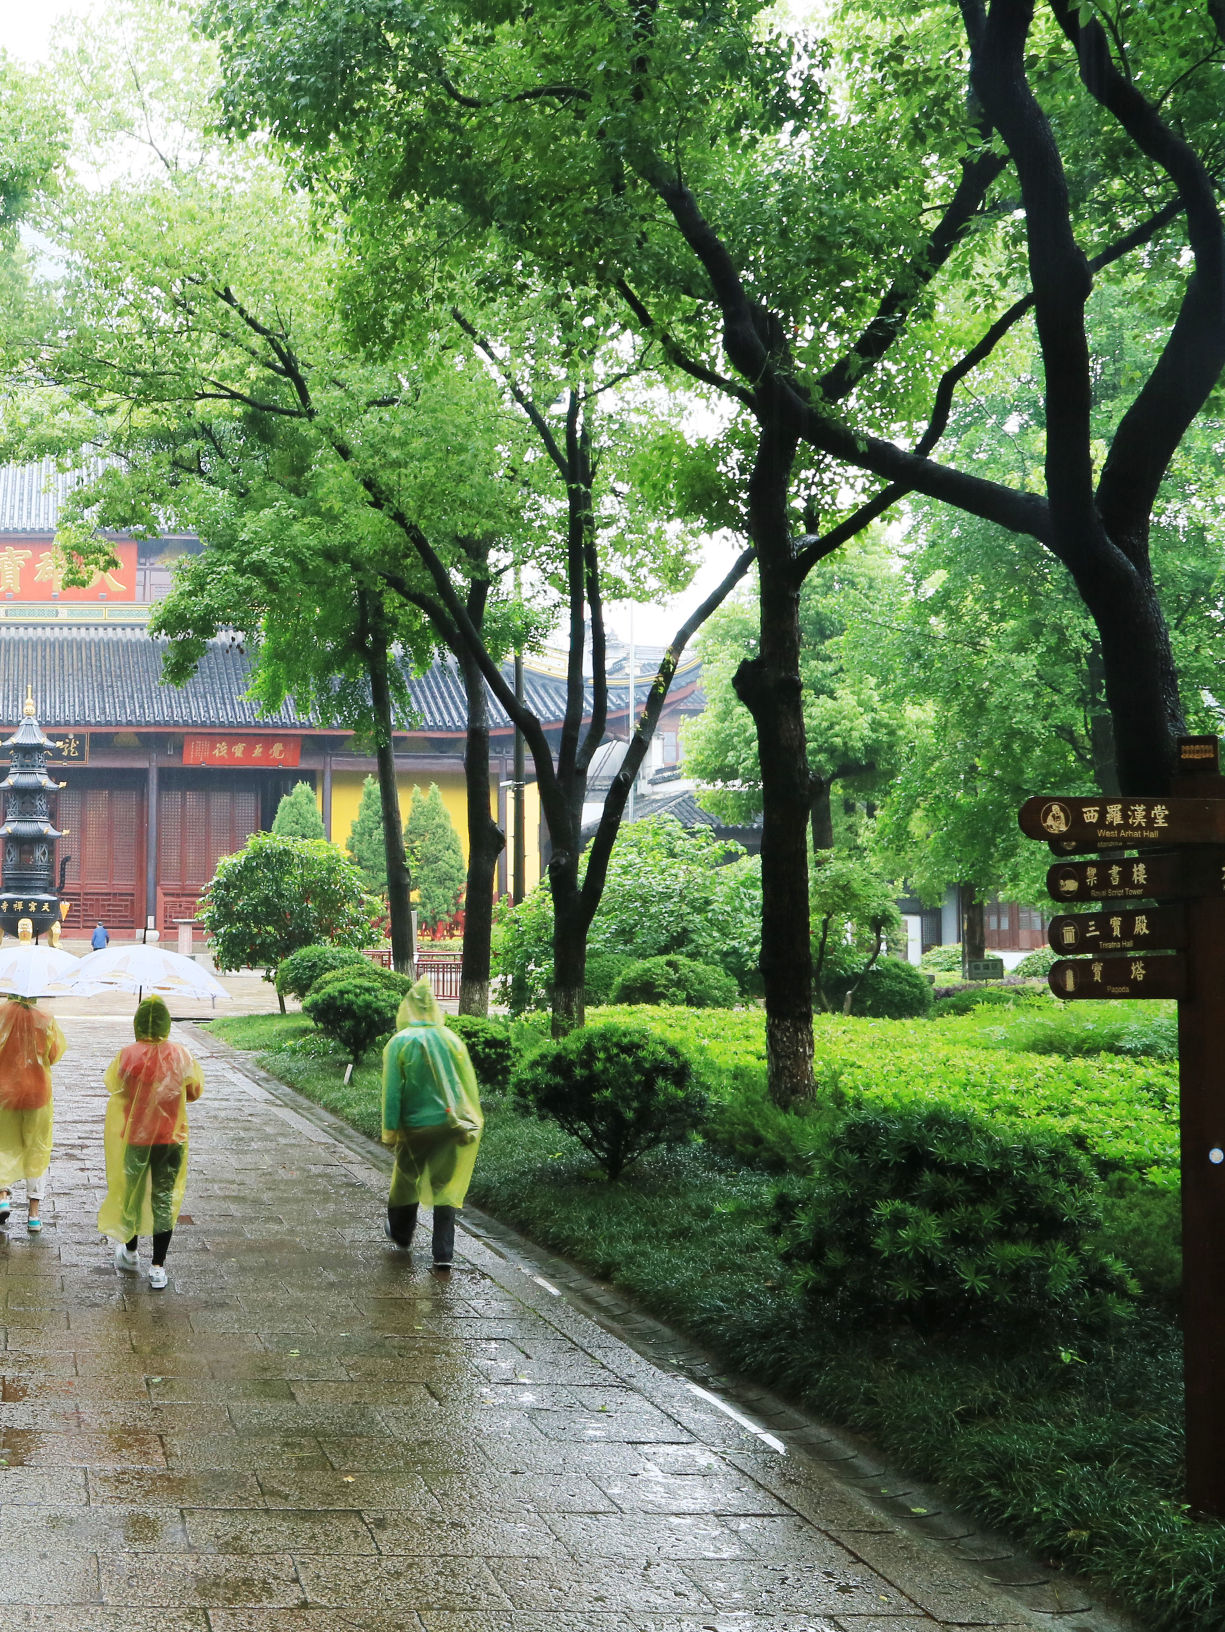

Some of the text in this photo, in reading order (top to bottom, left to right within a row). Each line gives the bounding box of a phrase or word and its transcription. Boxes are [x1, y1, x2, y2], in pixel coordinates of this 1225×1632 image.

[1081, 804, 1170, 828] 西羅漢堂
[1097, 829, 1159, 838] West Arhat Hall
[1124, 887, 1144, 896] Tower
[1085, 915, 1151, 938] 三寶殿
[1121, 940, 1134, 948] Hall
[1091, 961, 1147, 983] 寶塔
[1106, 985, 1130, 994] Pagoda
